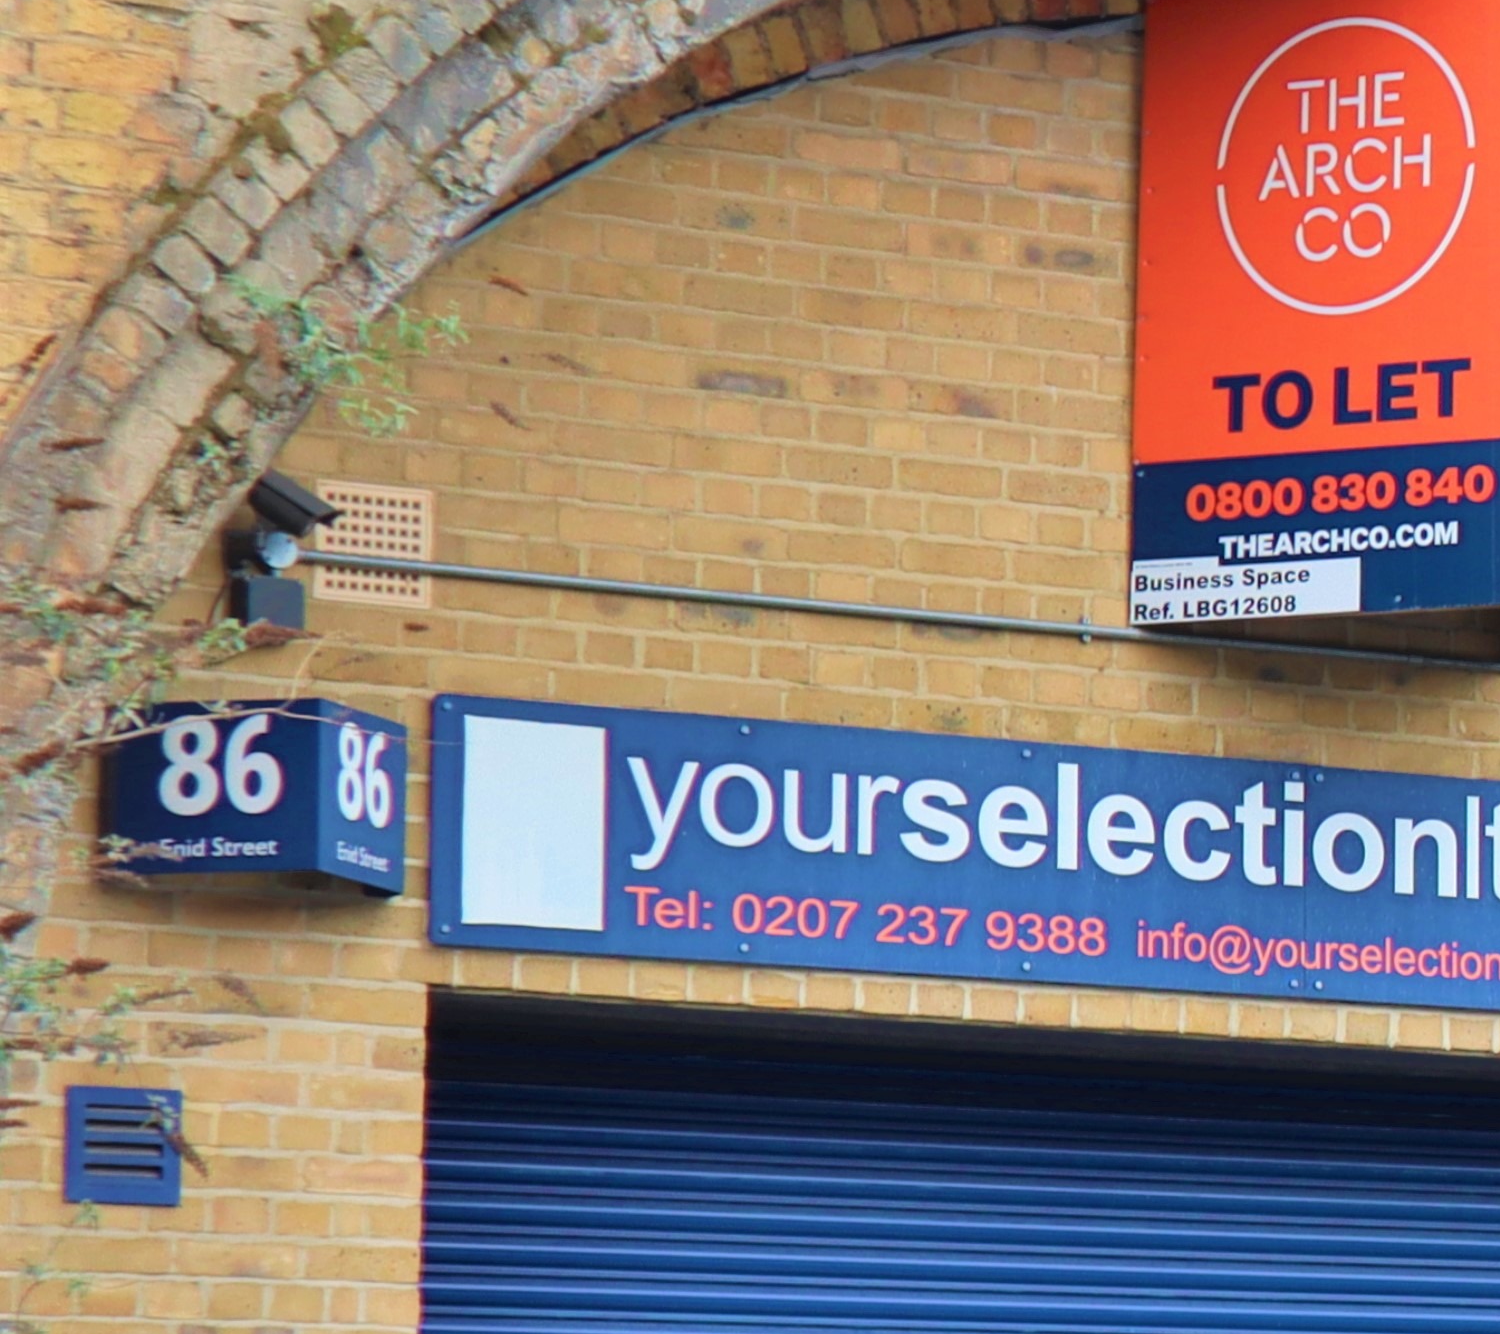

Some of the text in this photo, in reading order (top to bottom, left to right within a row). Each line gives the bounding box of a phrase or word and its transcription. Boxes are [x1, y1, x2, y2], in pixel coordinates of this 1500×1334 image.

[1286, 71, 1406, 134] THE
[1258, 133, 1433, 201] ARCH
[1295, 202, 1391, 262] CO
[1213, 357, 1471, 433] TO LET
[1185, 464, 1495, 521] 0800 830 840
[1218, 521, 1459, 560] THEARCHCO.COM
[1134, 568, 1310, 592] Business Space
[1134, 595, 1297, 621] Ref. LBG12608
[158, 714, 282, 816] 86
[337, 722, 391, 829] 86
[159, 837, 278, 858] Enid Street
[623, 885, 713, 933] Tel:
[732, 892, 857, 941] 0207
[875, 900, 964, 949] 237
[985, 906, 1107, 958] 9388
